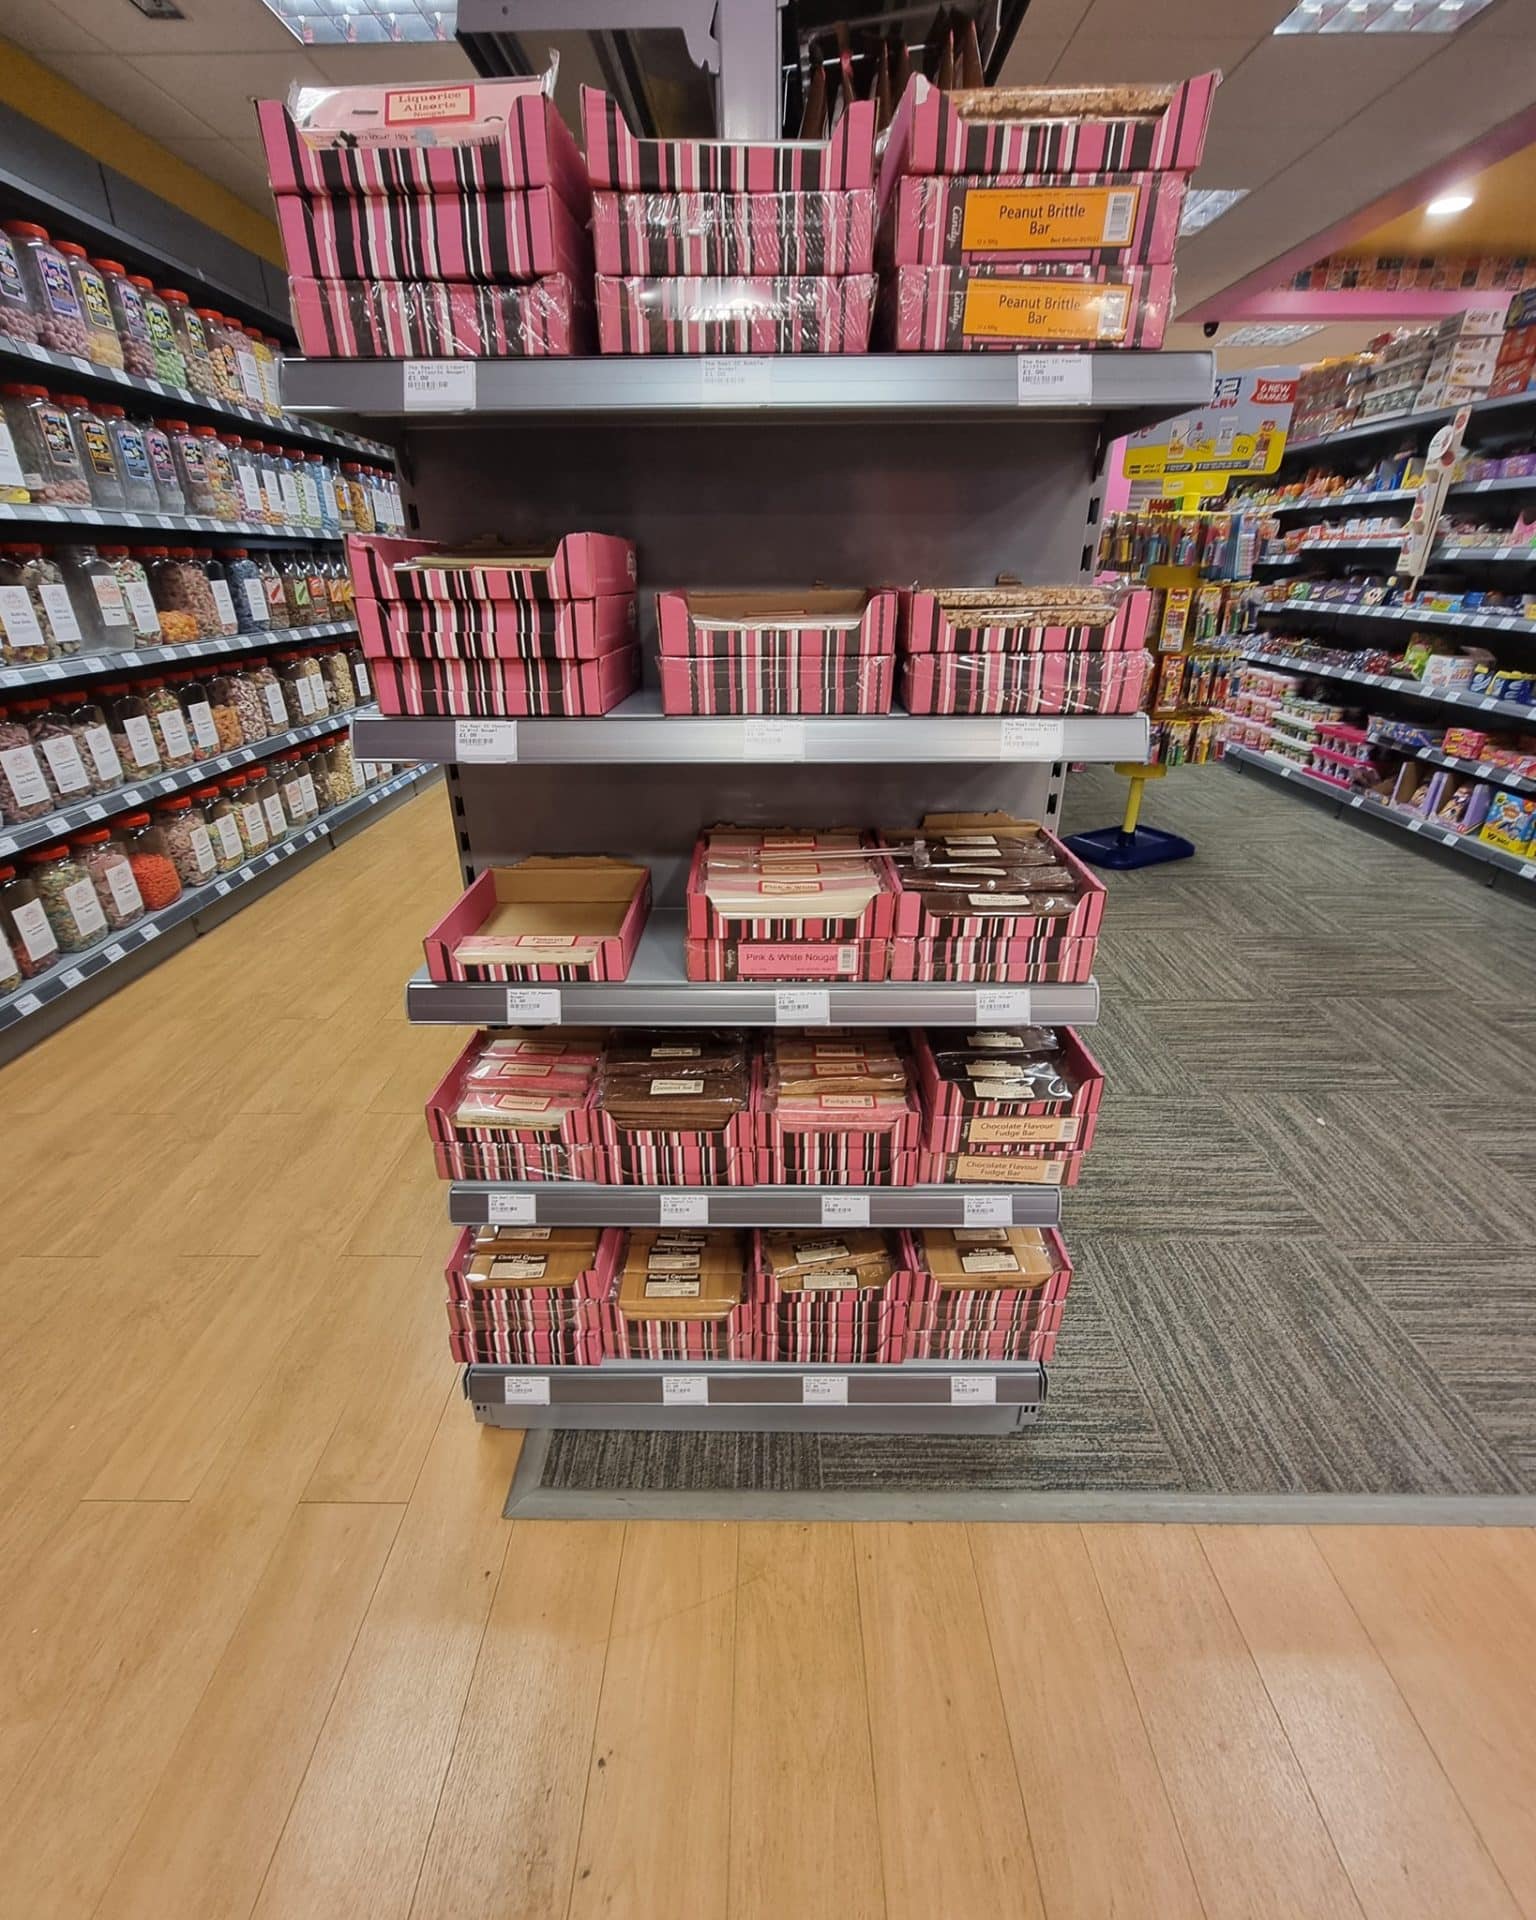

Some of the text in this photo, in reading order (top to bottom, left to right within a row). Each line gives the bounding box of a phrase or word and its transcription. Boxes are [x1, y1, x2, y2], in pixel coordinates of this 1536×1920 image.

[398, 91, 462, 104] Liquorice
[403, 101, 457, 112] Allsorts
[999, 203, 1086, 220] Peanut Brittle
[1029, 220, 1051, 236] Bar
[998, 294, 1081, 312] Peanut Brittle
[1027, 311, 1048, 325] Bar
[746, 953, 838, 963] Pink & White Nougat
[980, 1122, 1054, 1130] Chocolate Flavour
[994, 1130, 1021, 1138] Fudge
[966, 1160, 1005, 1169] Chocolate
[1008, 1162, 1039, 1170] Flavour
[980, 1169, 1021, 1177] Fudge Bar
